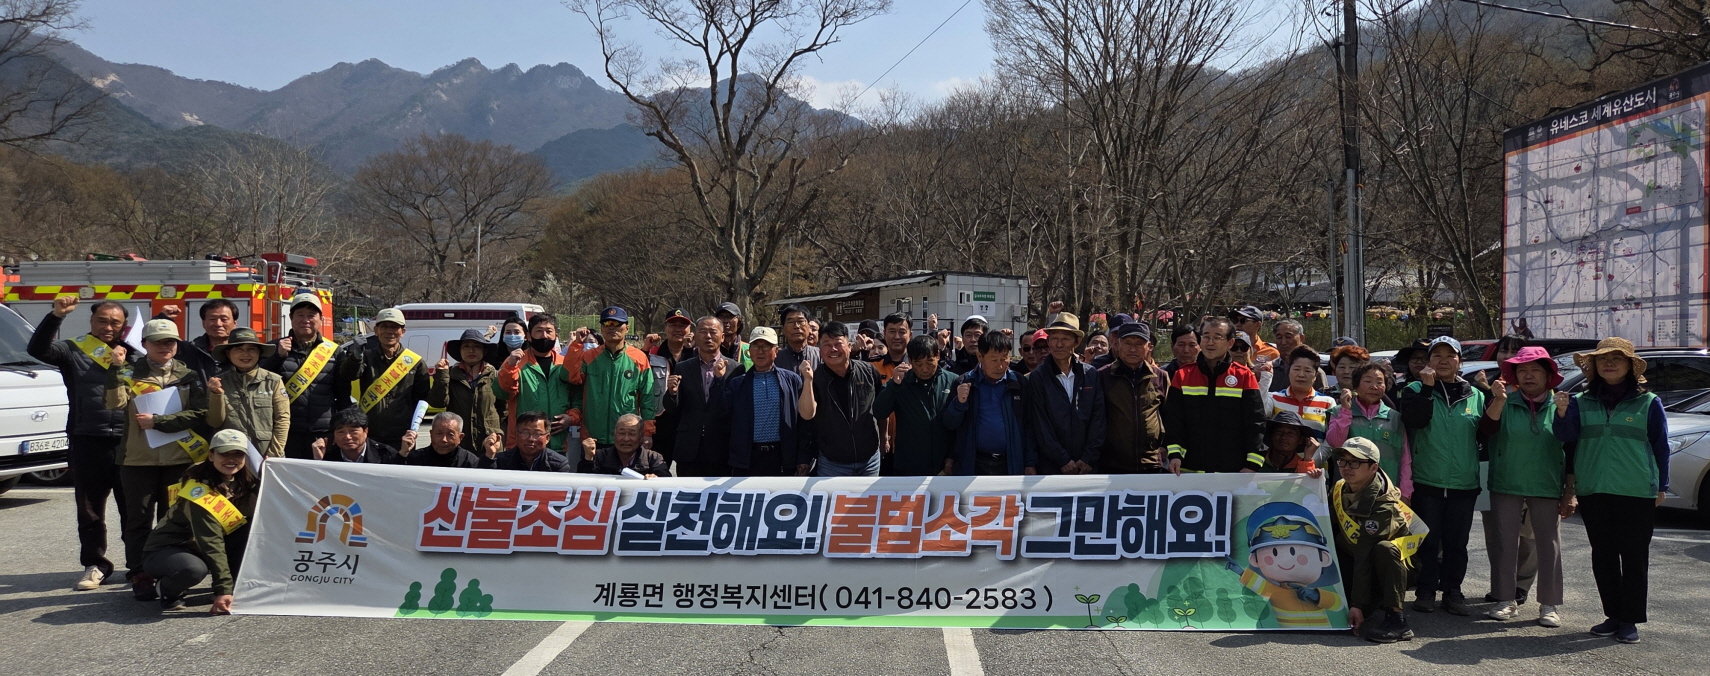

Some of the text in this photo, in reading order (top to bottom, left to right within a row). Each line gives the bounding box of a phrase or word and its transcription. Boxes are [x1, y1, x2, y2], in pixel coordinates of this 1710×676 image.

[1550, 87, 1656, 135] 유네스코 세계유산도시
[418, 484, 1229, 556] 산불조심 실천해요! 불법소각 그만해요!
[293, 550, 359, 575] 공주시
[290, 574, 355, 584] GONGJU CITY
[593, 582, 665, 608] 계룡면
[835, 586, 1037, 610] 041-840-2583
